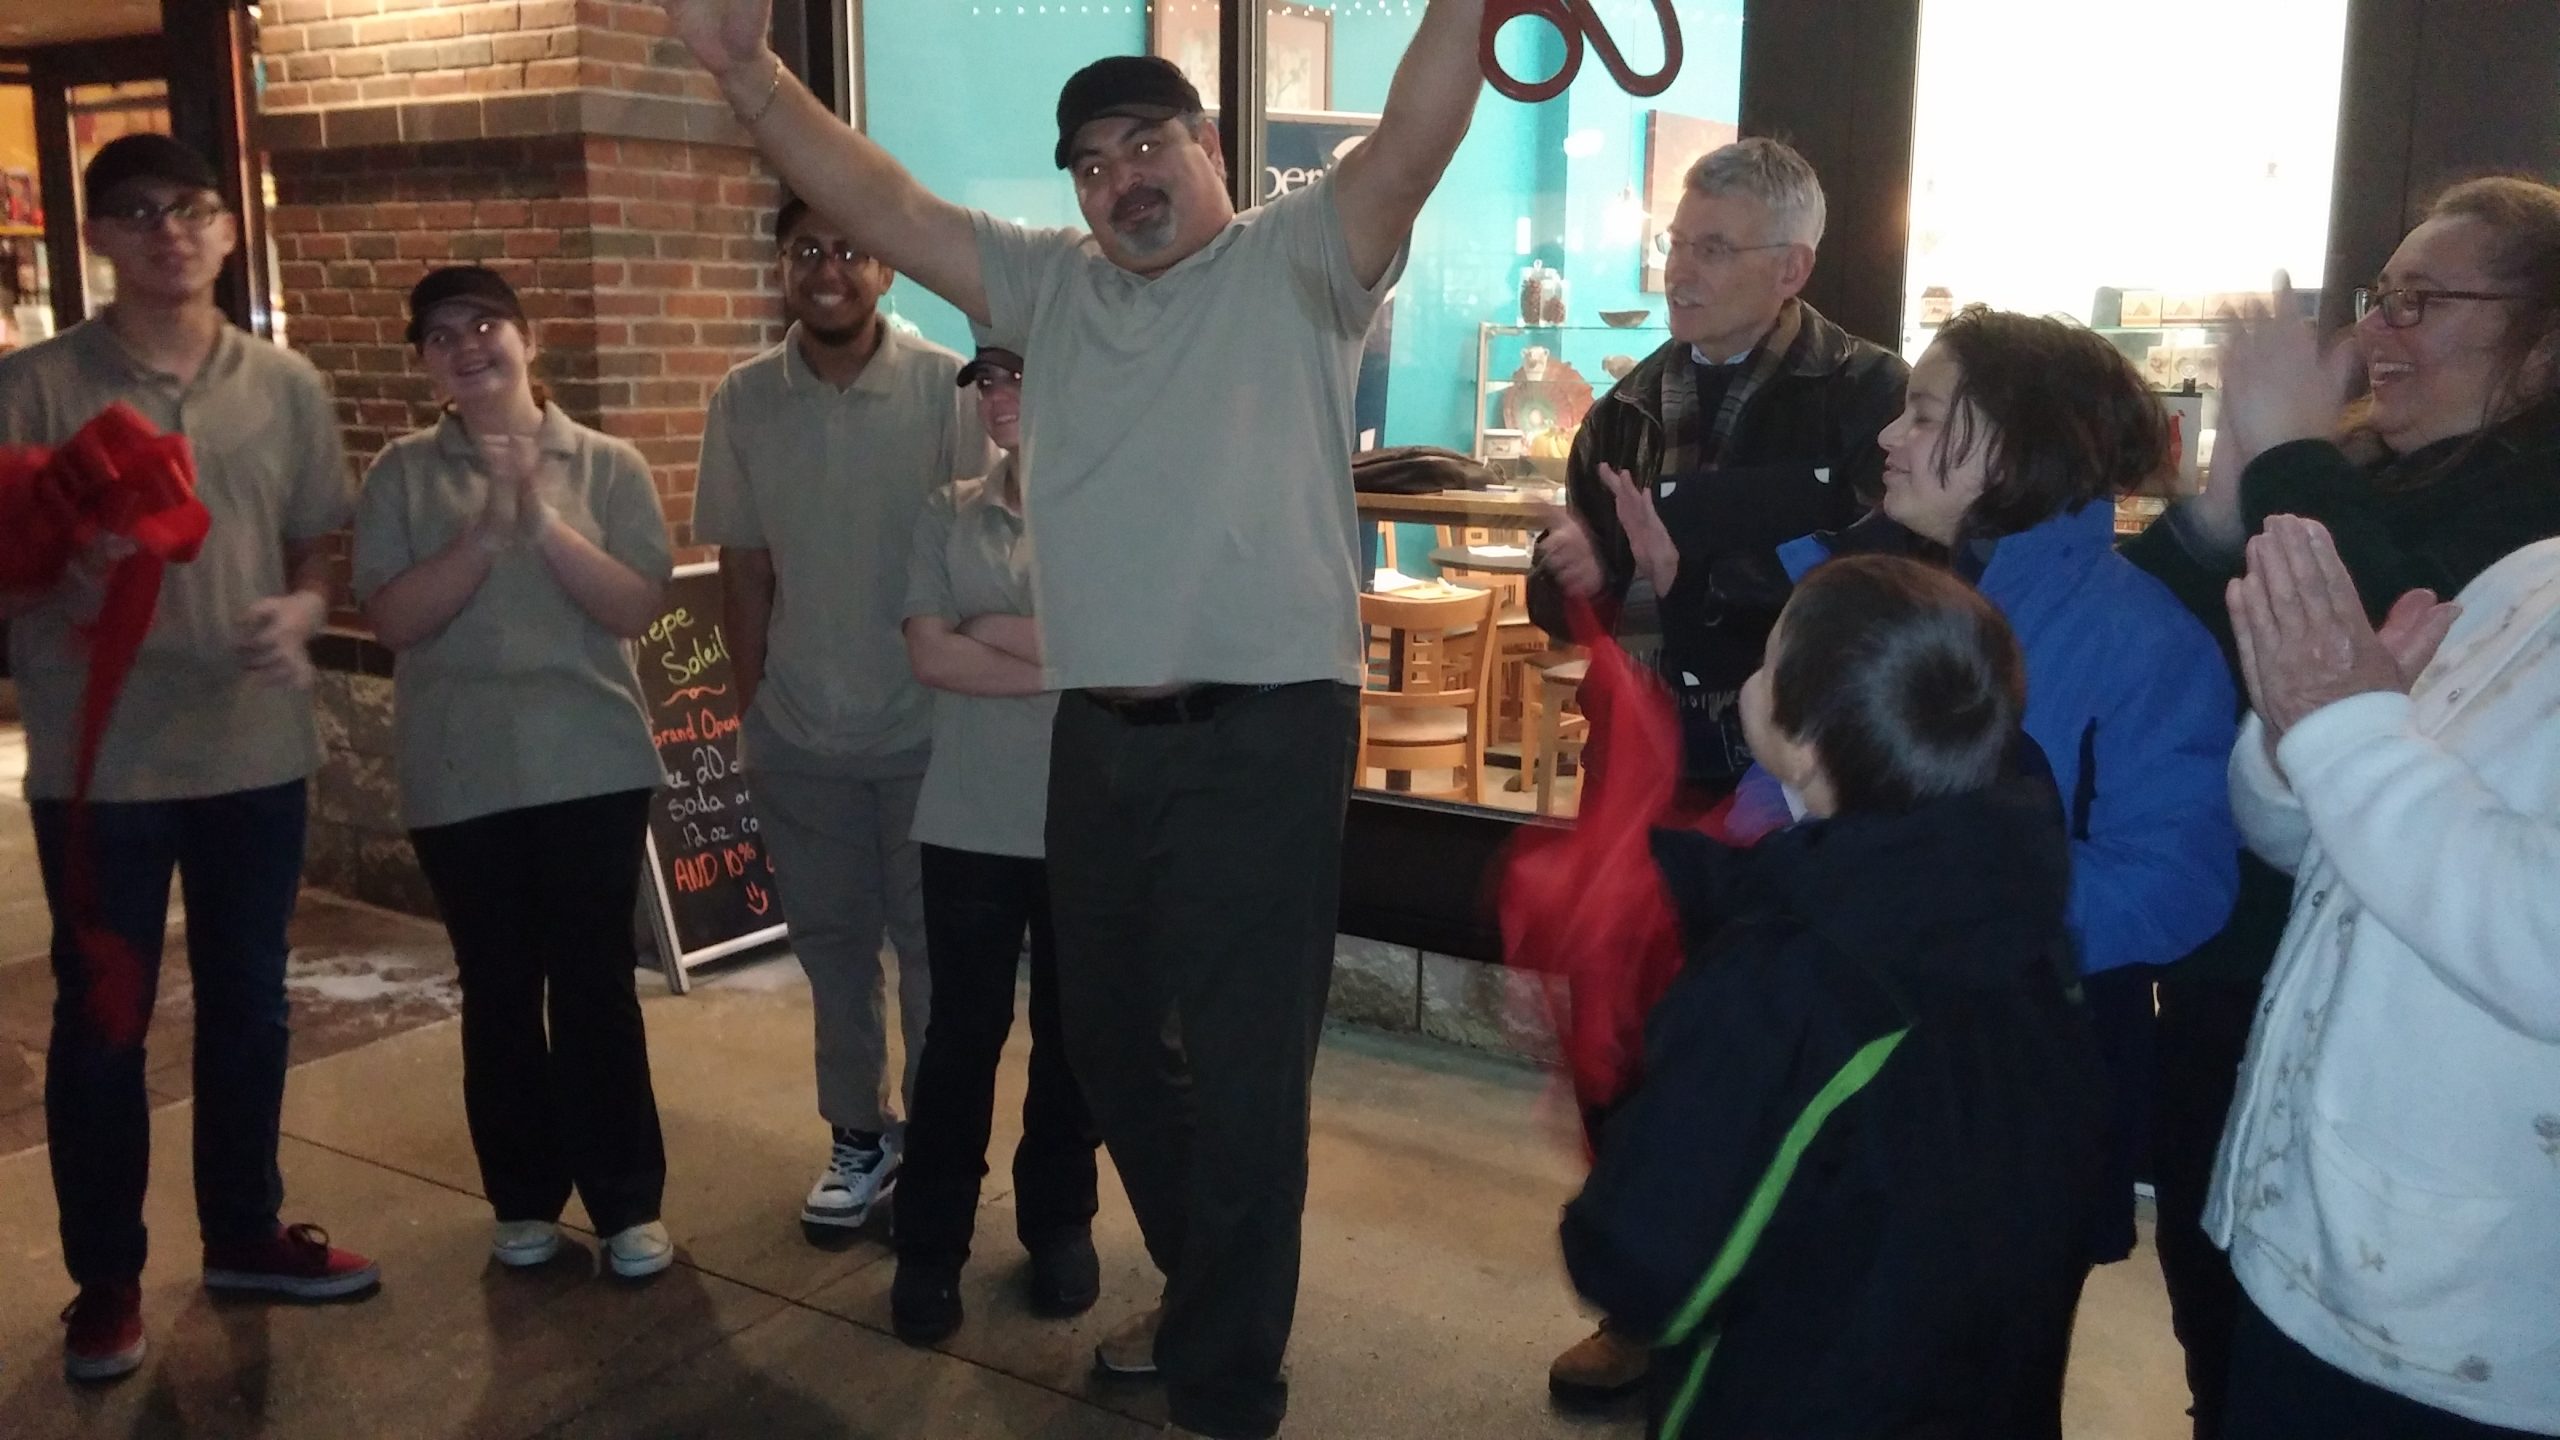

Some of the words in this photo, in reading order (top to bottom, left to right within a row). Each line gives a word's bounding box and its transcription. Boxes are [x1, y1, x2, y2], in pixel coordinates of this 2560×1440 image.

[661, 624, 731, 685] Soleil
[692, 744, 725, 784] 20
[674, 852, 718, 892] AND
[723, 842, 757, 878] 10%
